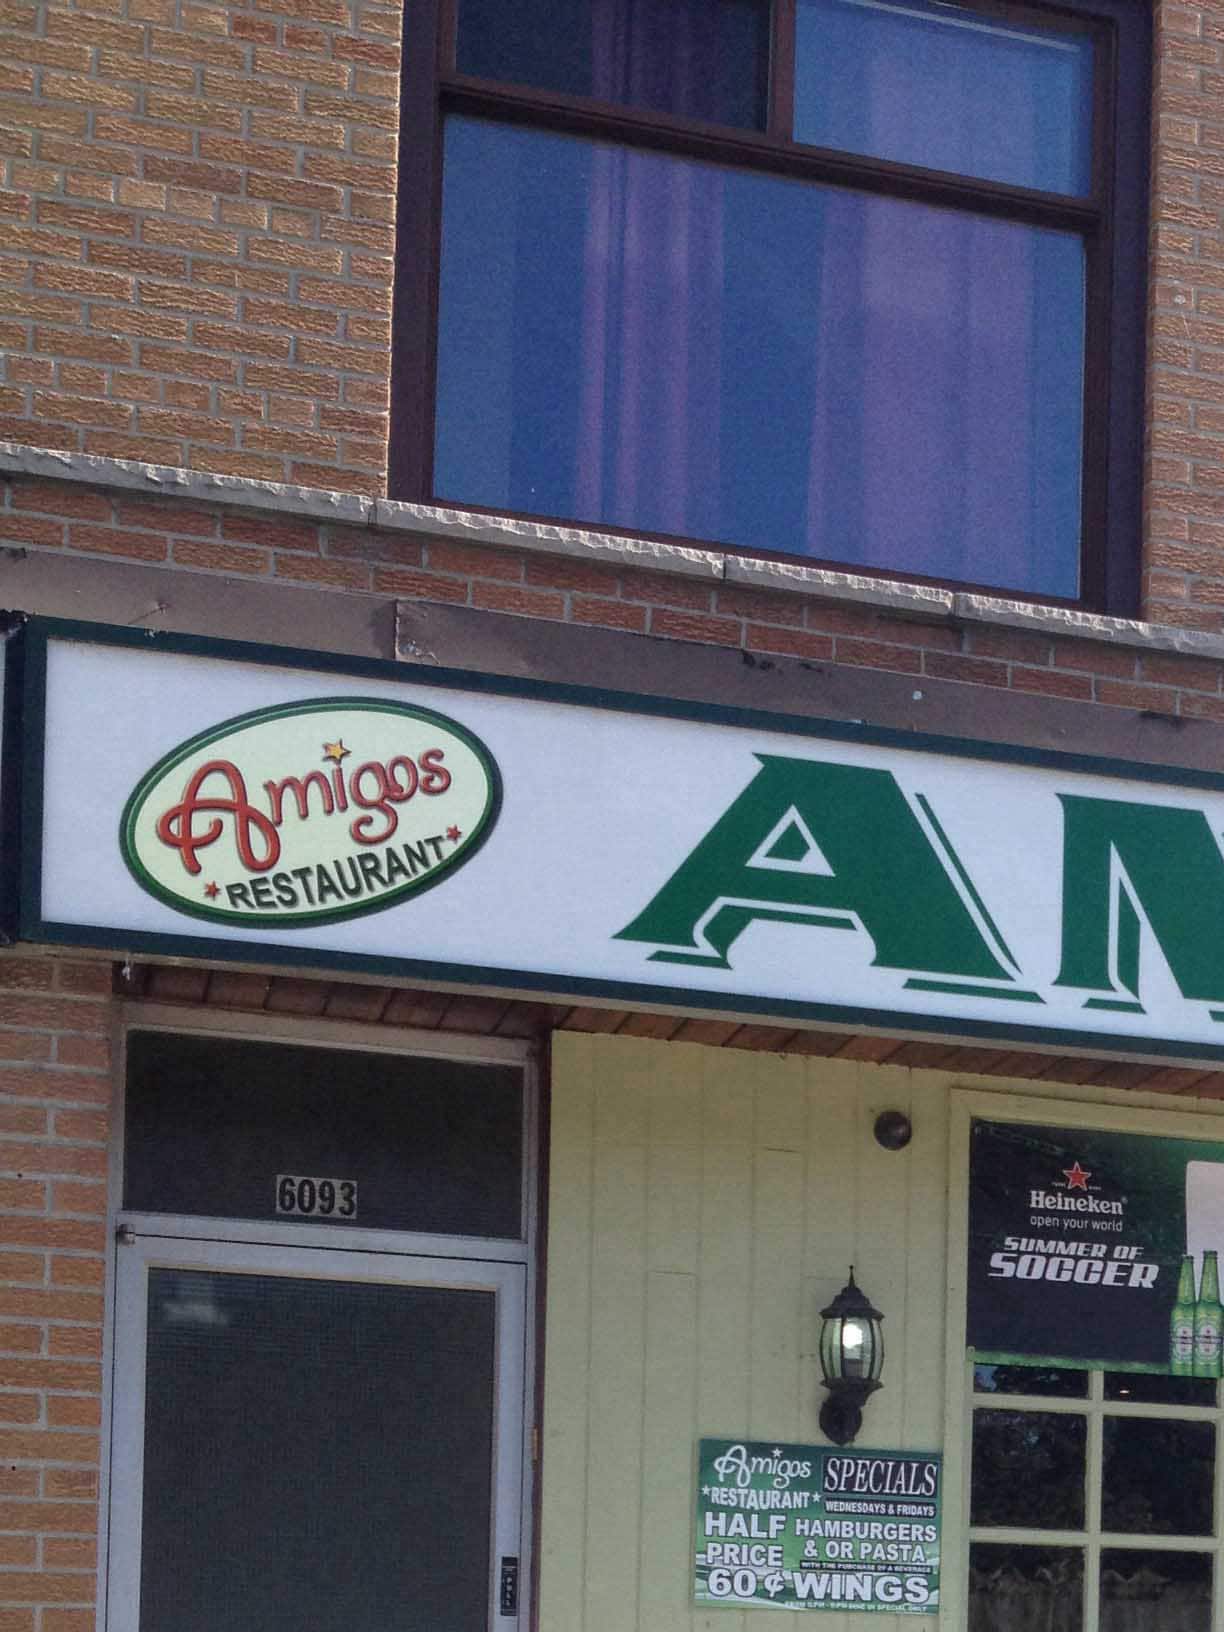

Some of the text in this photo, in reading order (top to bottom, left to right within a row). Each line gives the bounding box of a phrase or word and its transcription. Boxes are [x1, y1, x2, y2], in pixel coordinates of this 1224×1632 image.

[156, 740, 453, 875] Amigos
[226, 835, 446, 909] RESTAURANT
[279, 1177, 356, 1217] 6093
[1029, 1190, 1125, 1215] Heineken
[1030, 1215, 1124, 1232] open your world
[1003, 1236, 1145, 1261] SUMMER OF
[987, 1252, 1161, 1289] SOCCER
[714, 1444, 812, 1489] Amigos
[823, 1456, 938, 1497] SPECIALS
[710, 1486, 811, 1511] RESTAURANT
[825, 1500, 936, 1517] WEDNESDAYS & FRIDAYS
[703, 1511, 786, 1539] HALF
[795, 1518, 938, 1543] HAMBURGERS
[706, 1541, 784, 1568] PRICE
[803, 1540, 927, 1563] & OR PASTA
[792, 1572, 930, 1604] WINGS
